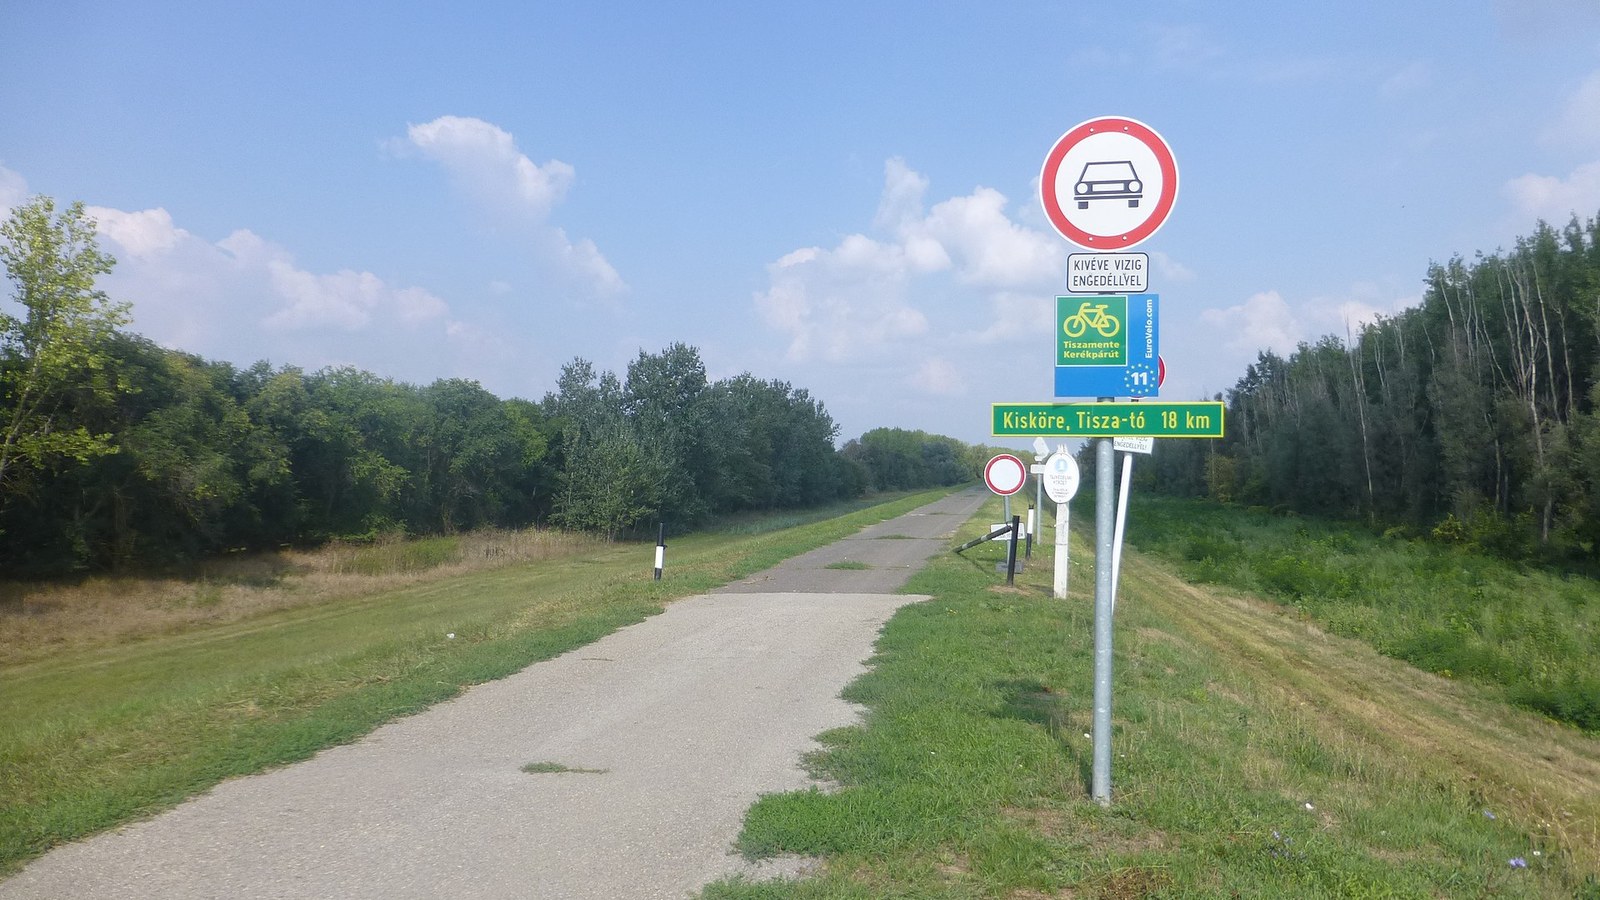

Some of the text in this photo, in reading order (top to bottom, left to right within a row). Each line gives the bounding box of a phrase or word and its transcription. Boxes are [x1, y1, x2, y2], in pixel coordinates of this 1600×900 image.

[1073, 257, 1142, 271] KIVÉVE VIZIG
[1073, 272, 1142, 287] ENGEDÉLLYEL
[1145, 299, 1153, 359] EuroVelo.com
[1063, 340, 1120, 349] Tiszamente
[1063, 349, 1120, 360] Kerékpárút
[1131, 372, 1148, 386] 11
[1003, 410, 1210, 432] Kisköre, Tisza-tó 18 km
